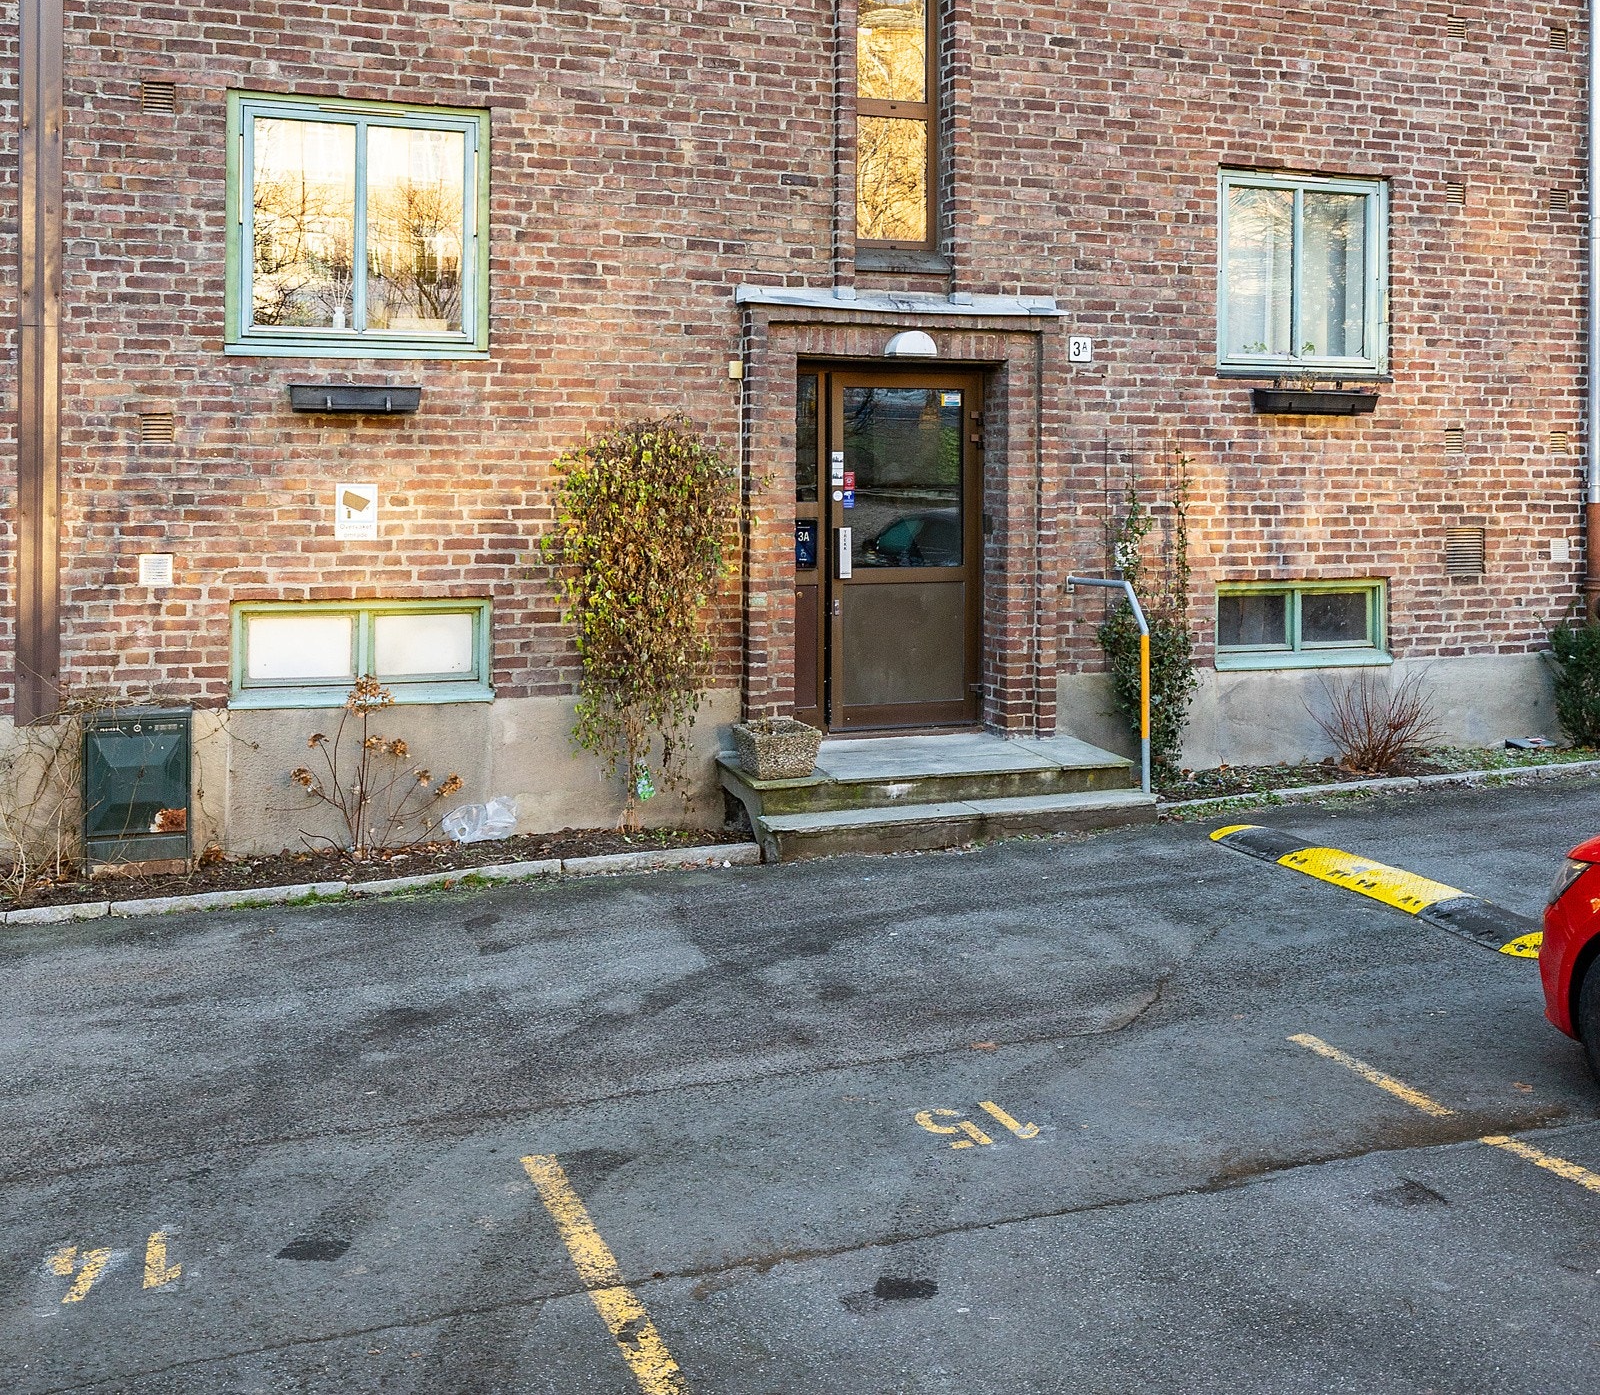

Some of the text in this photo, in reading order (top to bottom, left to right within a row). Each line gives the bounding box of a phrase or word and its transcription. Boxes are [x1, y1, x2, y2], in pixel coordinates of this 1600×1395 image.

[1073, 341, 1088, 357] 3A
[797, 531, 810, 542] 3A
[914, 1100, 1040, 1150] 15
